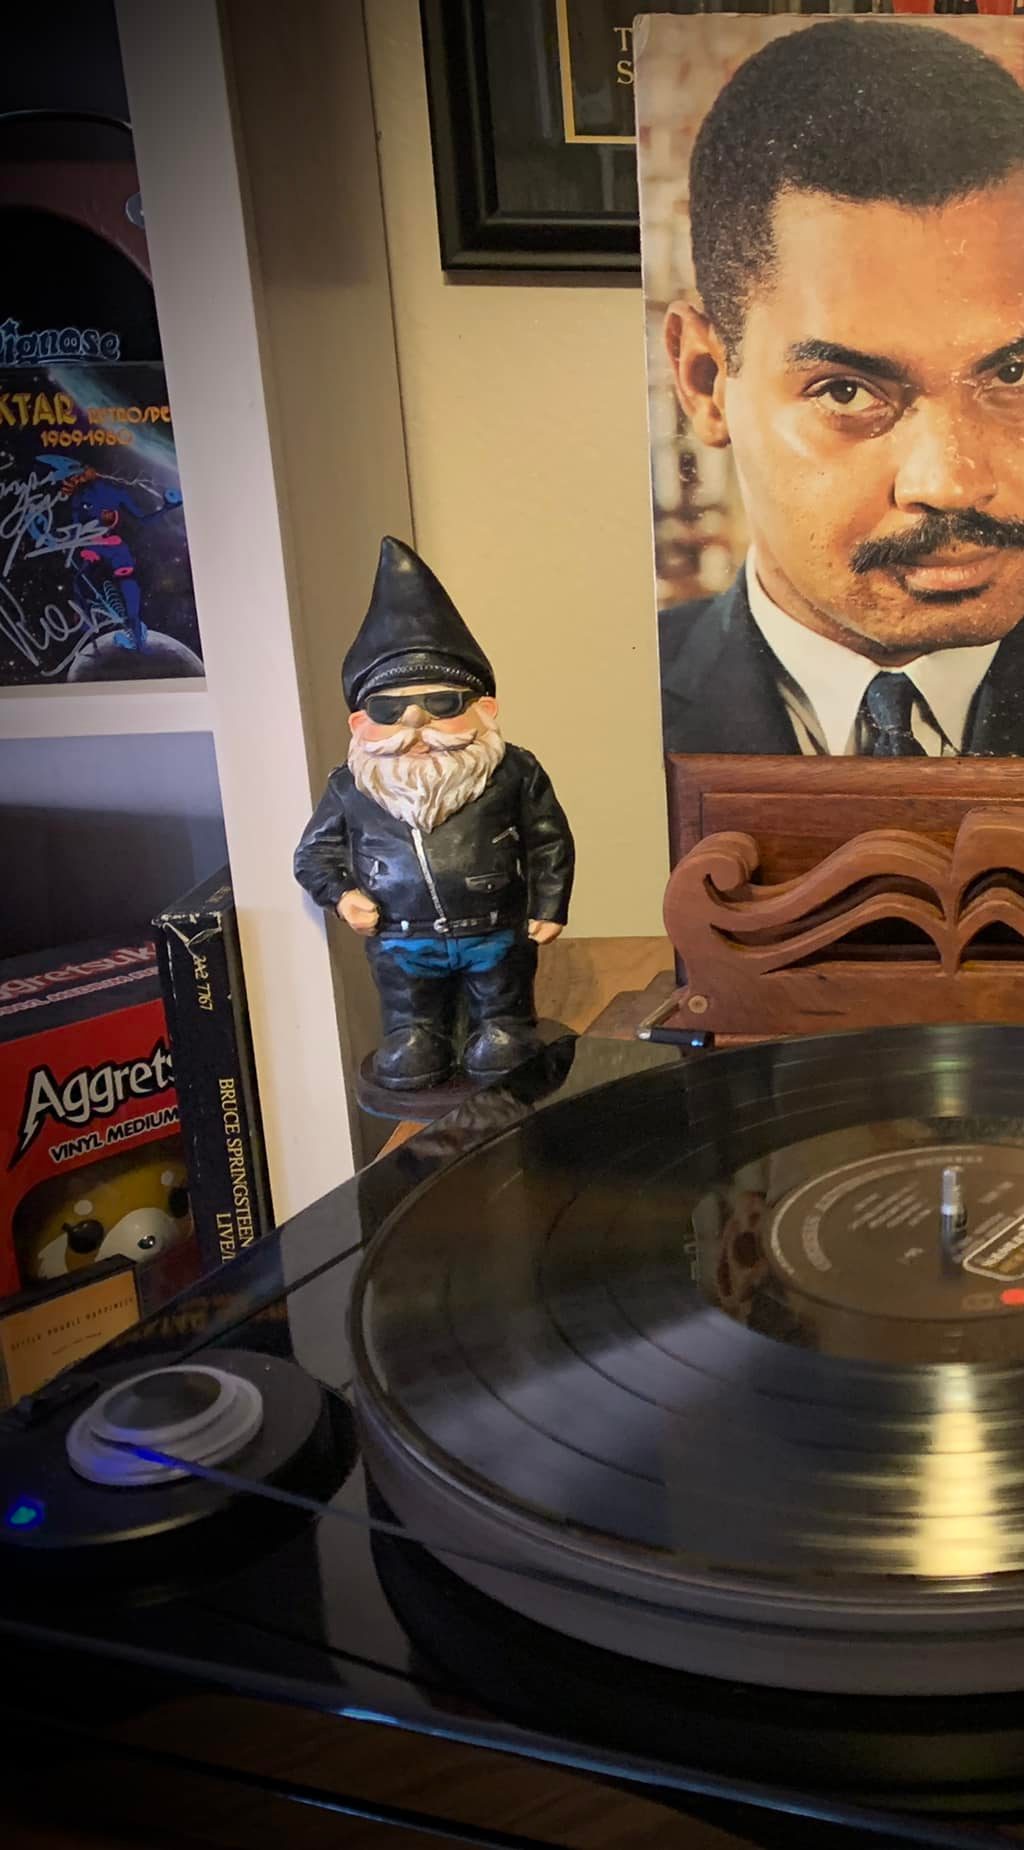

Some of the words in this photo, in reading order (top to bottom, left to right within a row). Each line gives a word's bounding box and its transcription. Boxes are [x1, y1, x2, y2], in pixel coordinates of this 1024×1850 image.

[617, 60, 634, 85] S
[0, 318, 120, 363] ignose
[0, 391, 78, 426] KTAR
[219, 1078, 239, 1134] BRUCE
[50, 1132, 103, 1163] VINYL
[106, 1105, 180, 1145] MEDIUM
[226, 1138, 255, 1249] SPRINGSTEEN
